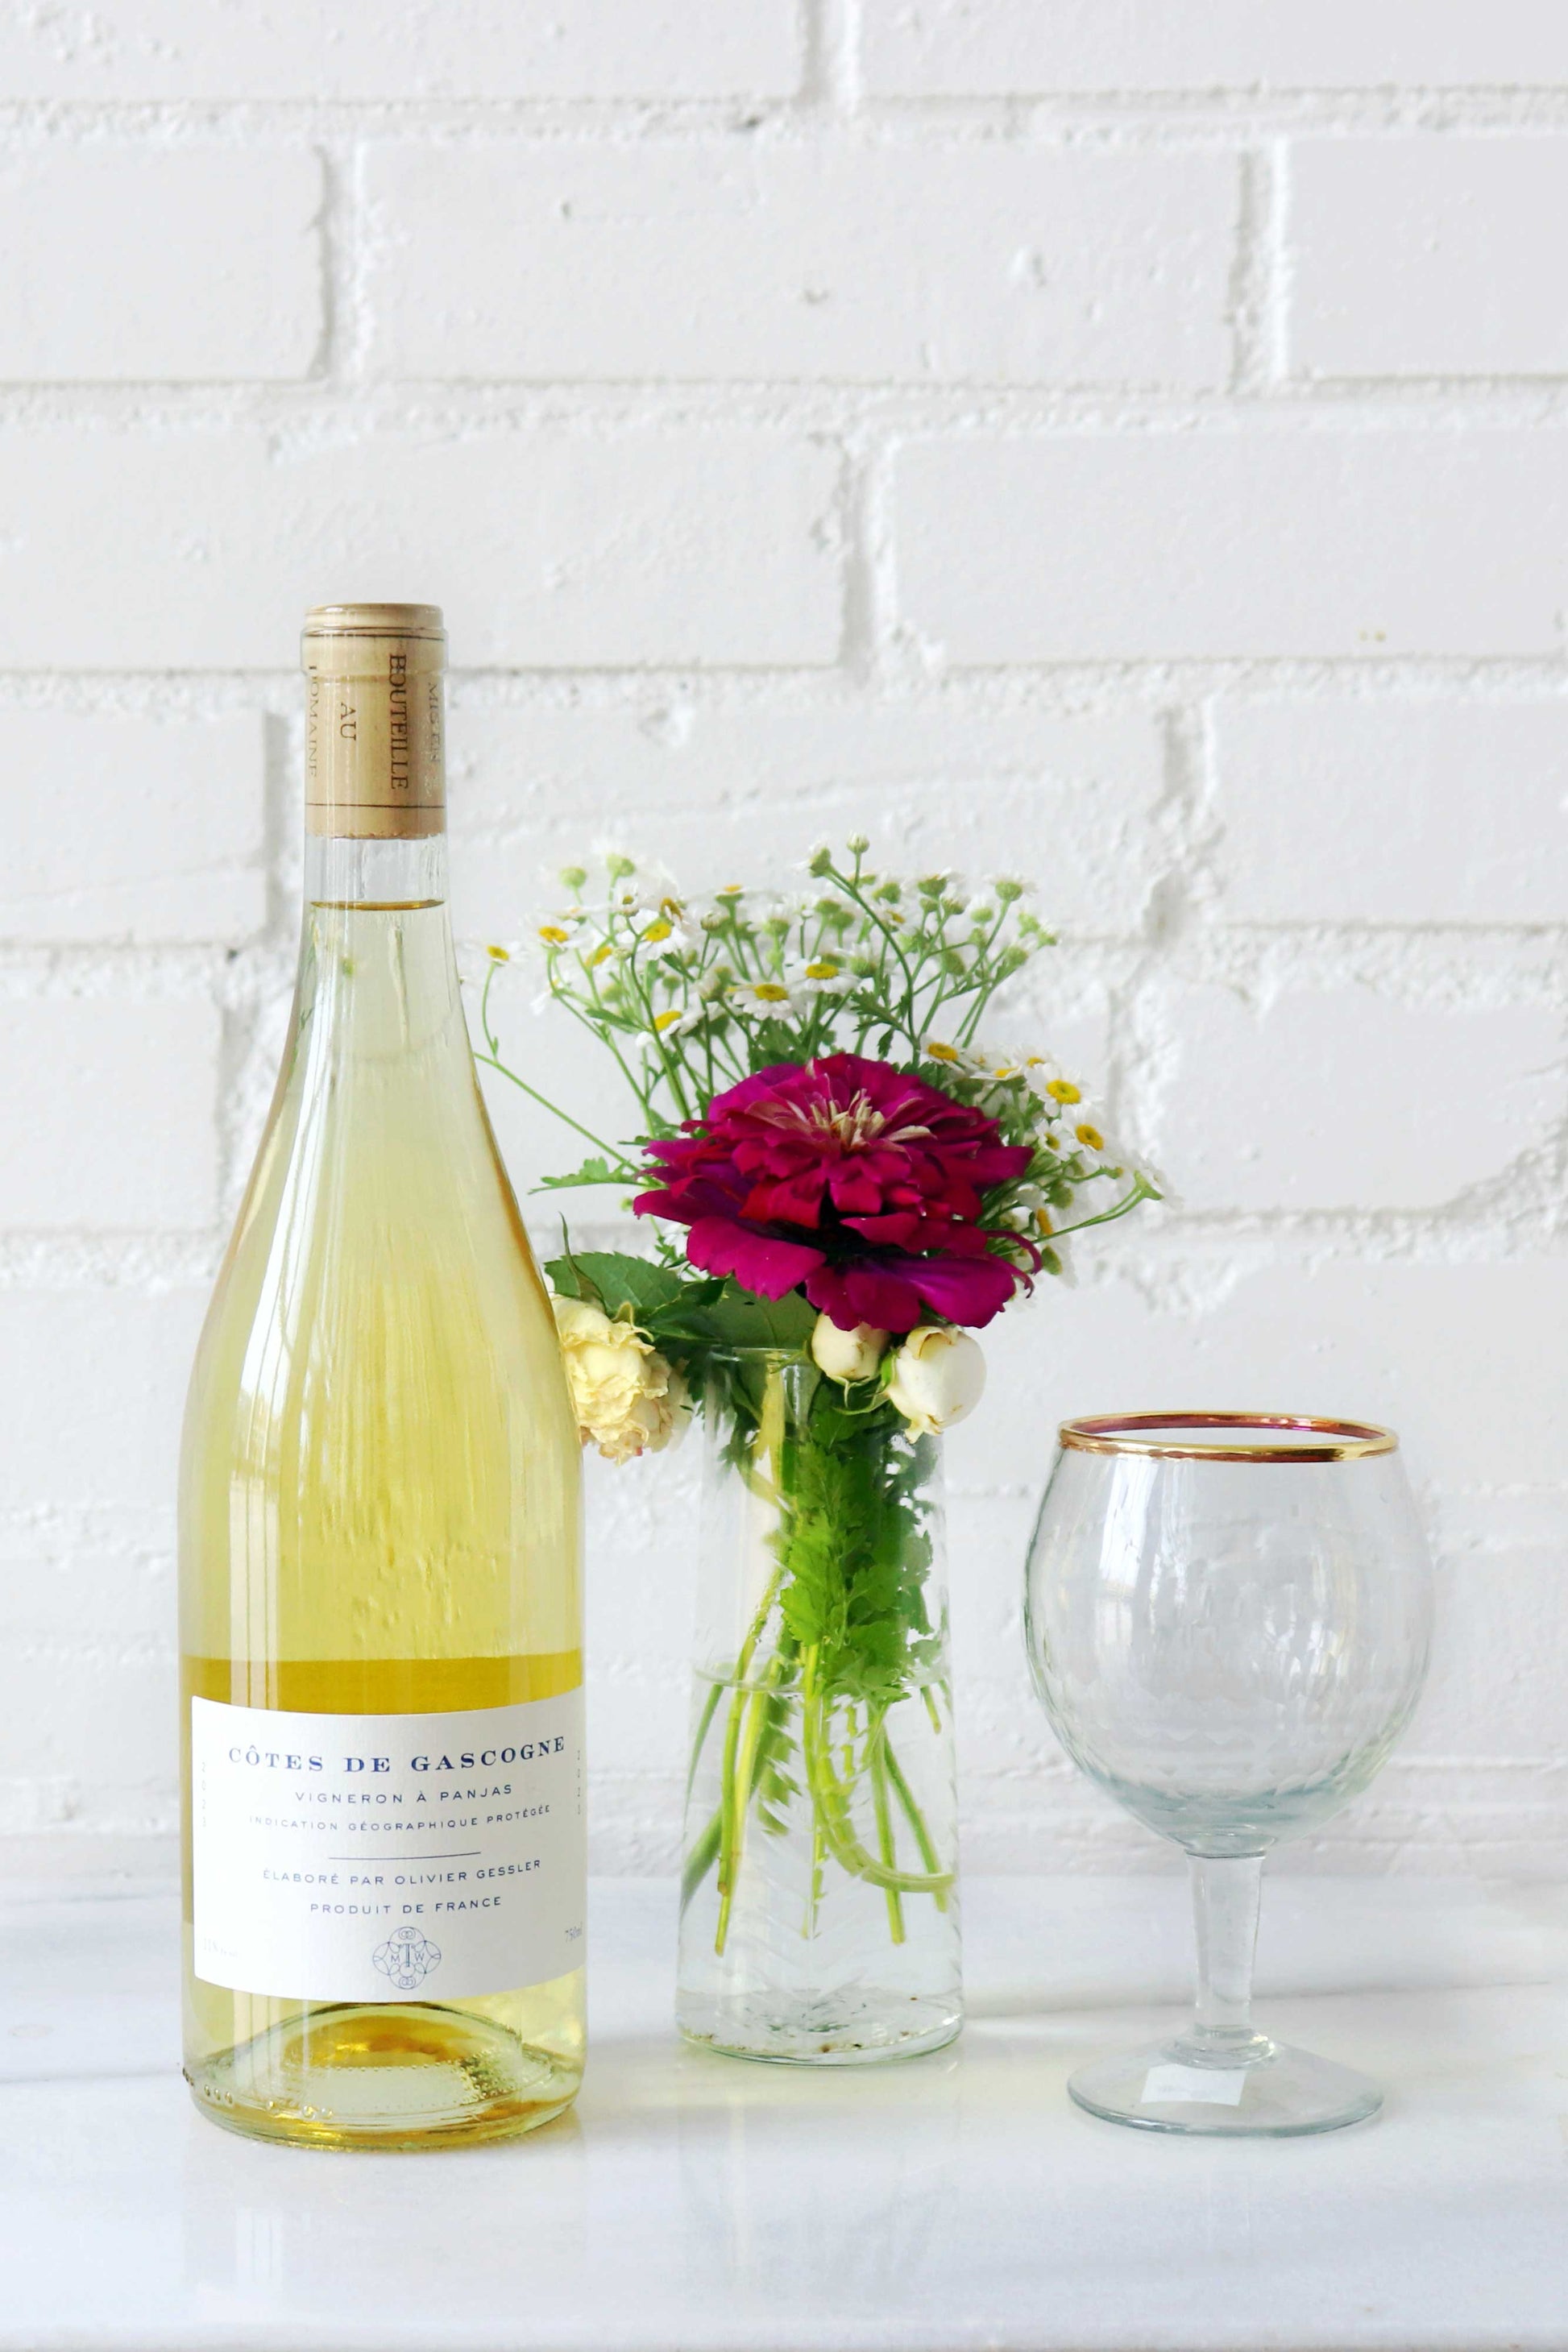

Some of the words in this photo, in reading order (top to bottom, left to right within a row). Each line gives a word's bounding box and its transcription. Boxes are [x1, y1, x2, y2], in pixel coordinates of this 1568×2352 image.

[340, 702, 357, 741] AU
[389, 653, 409, 790] BOUTEILLE
[229, 1744, 323, 1772] CÔTES
[343, 1757, 391, 1773] DE
[411, 1736, 565, 1772] GASCOGNE
[295, 1791, 403, 1804] VIGNERON
[417, 1790, 426, 1802] À
[440, 1784, 512, 1801] PANJAS
[249, 1815, 338, 1831] INDICATION
[348, 1817, 479, 1831] GÉOGRAPHIQUE
[487, 1804, 550, 1823] PROTÉGÉE
[263, 1868, 339, 1885] ÉLABORÉ
[350, 1876, 384, 1885] PAR
[395, 1871, 467, 1885] OLIVIER
[476, 1859, 541, 1880] GESSLER
[310, 1903, 391, 1914] PRODUIT
[402, 1904, 424, 1914] DE
[435, 1896, 502, 1912] FRANCE
